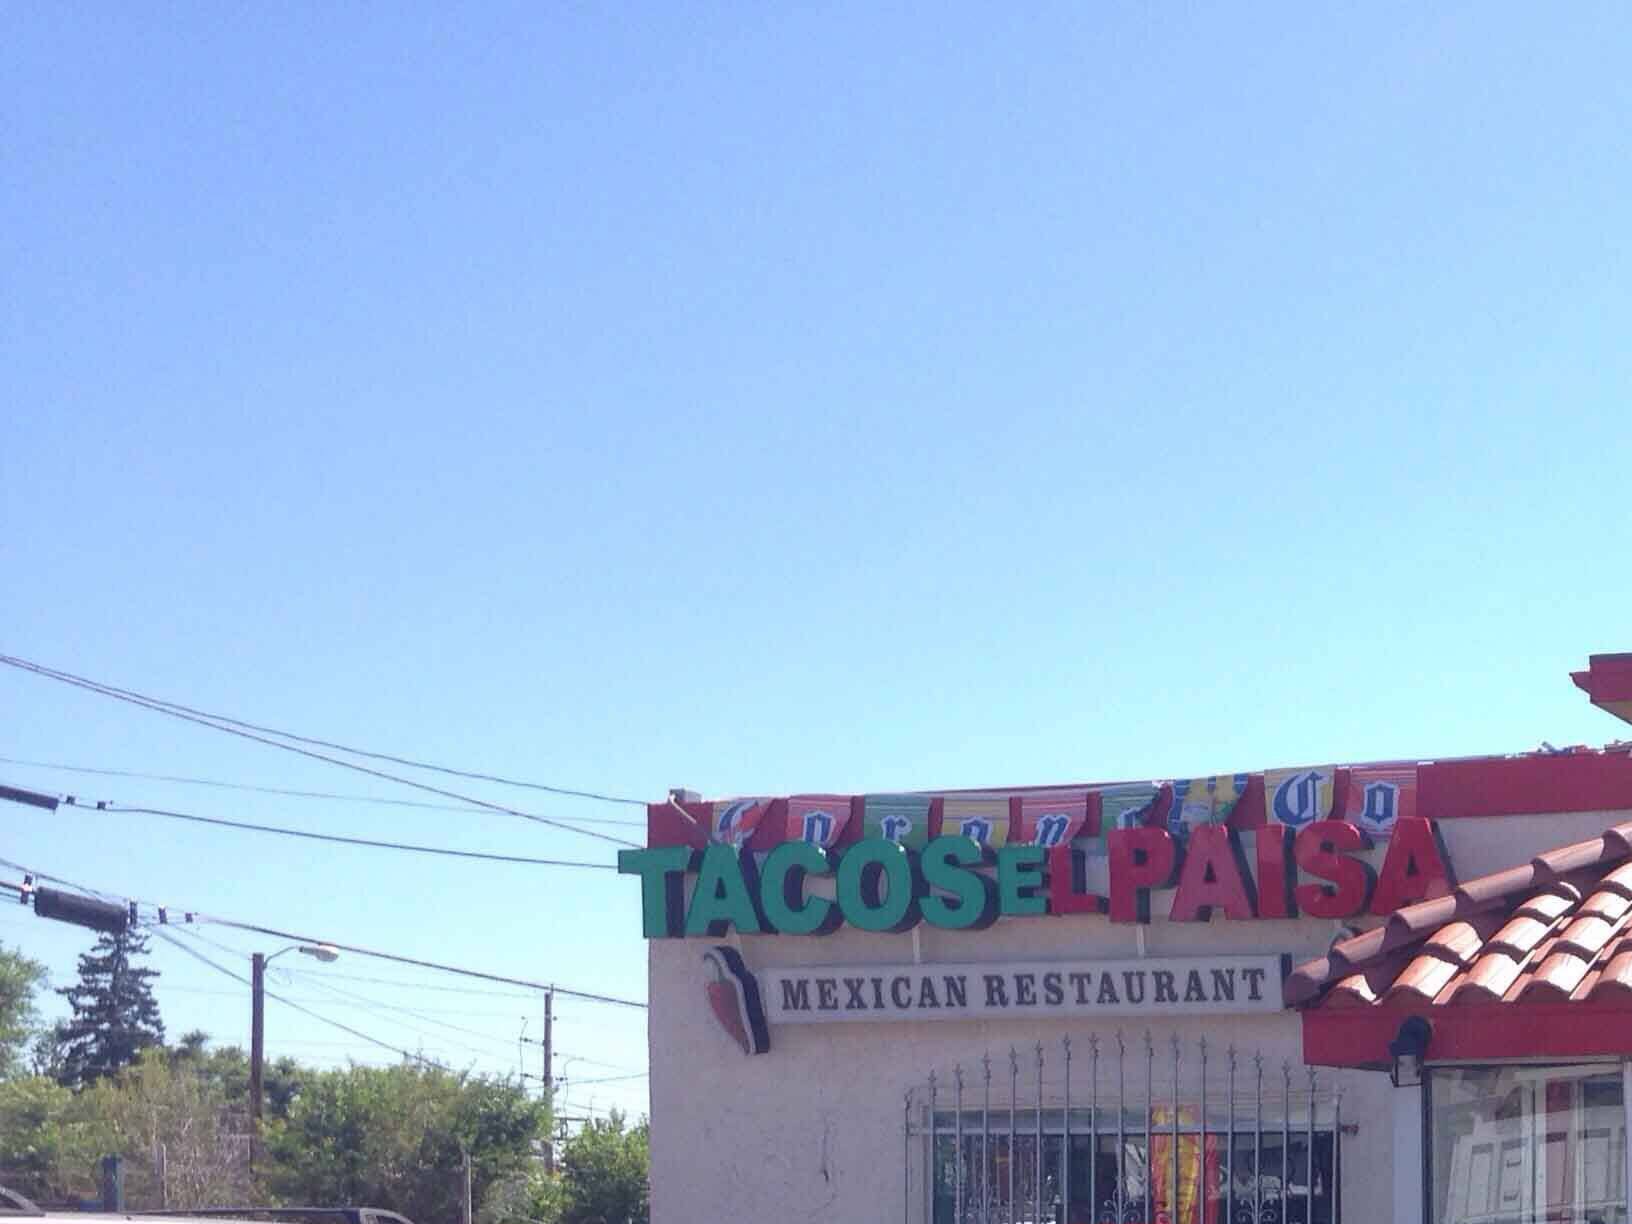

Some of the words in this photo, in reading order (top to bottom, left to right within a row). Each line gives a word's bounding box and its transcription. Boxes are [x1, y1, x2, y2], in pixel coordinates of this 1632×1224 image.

[618, 834, 1000, 938] TACOS
[1108, 816, 1454, 923] PAISA
[780, 974, 969, 1011] MEXICAN
[982, 966, 1267, 1006] RESTAURANT
